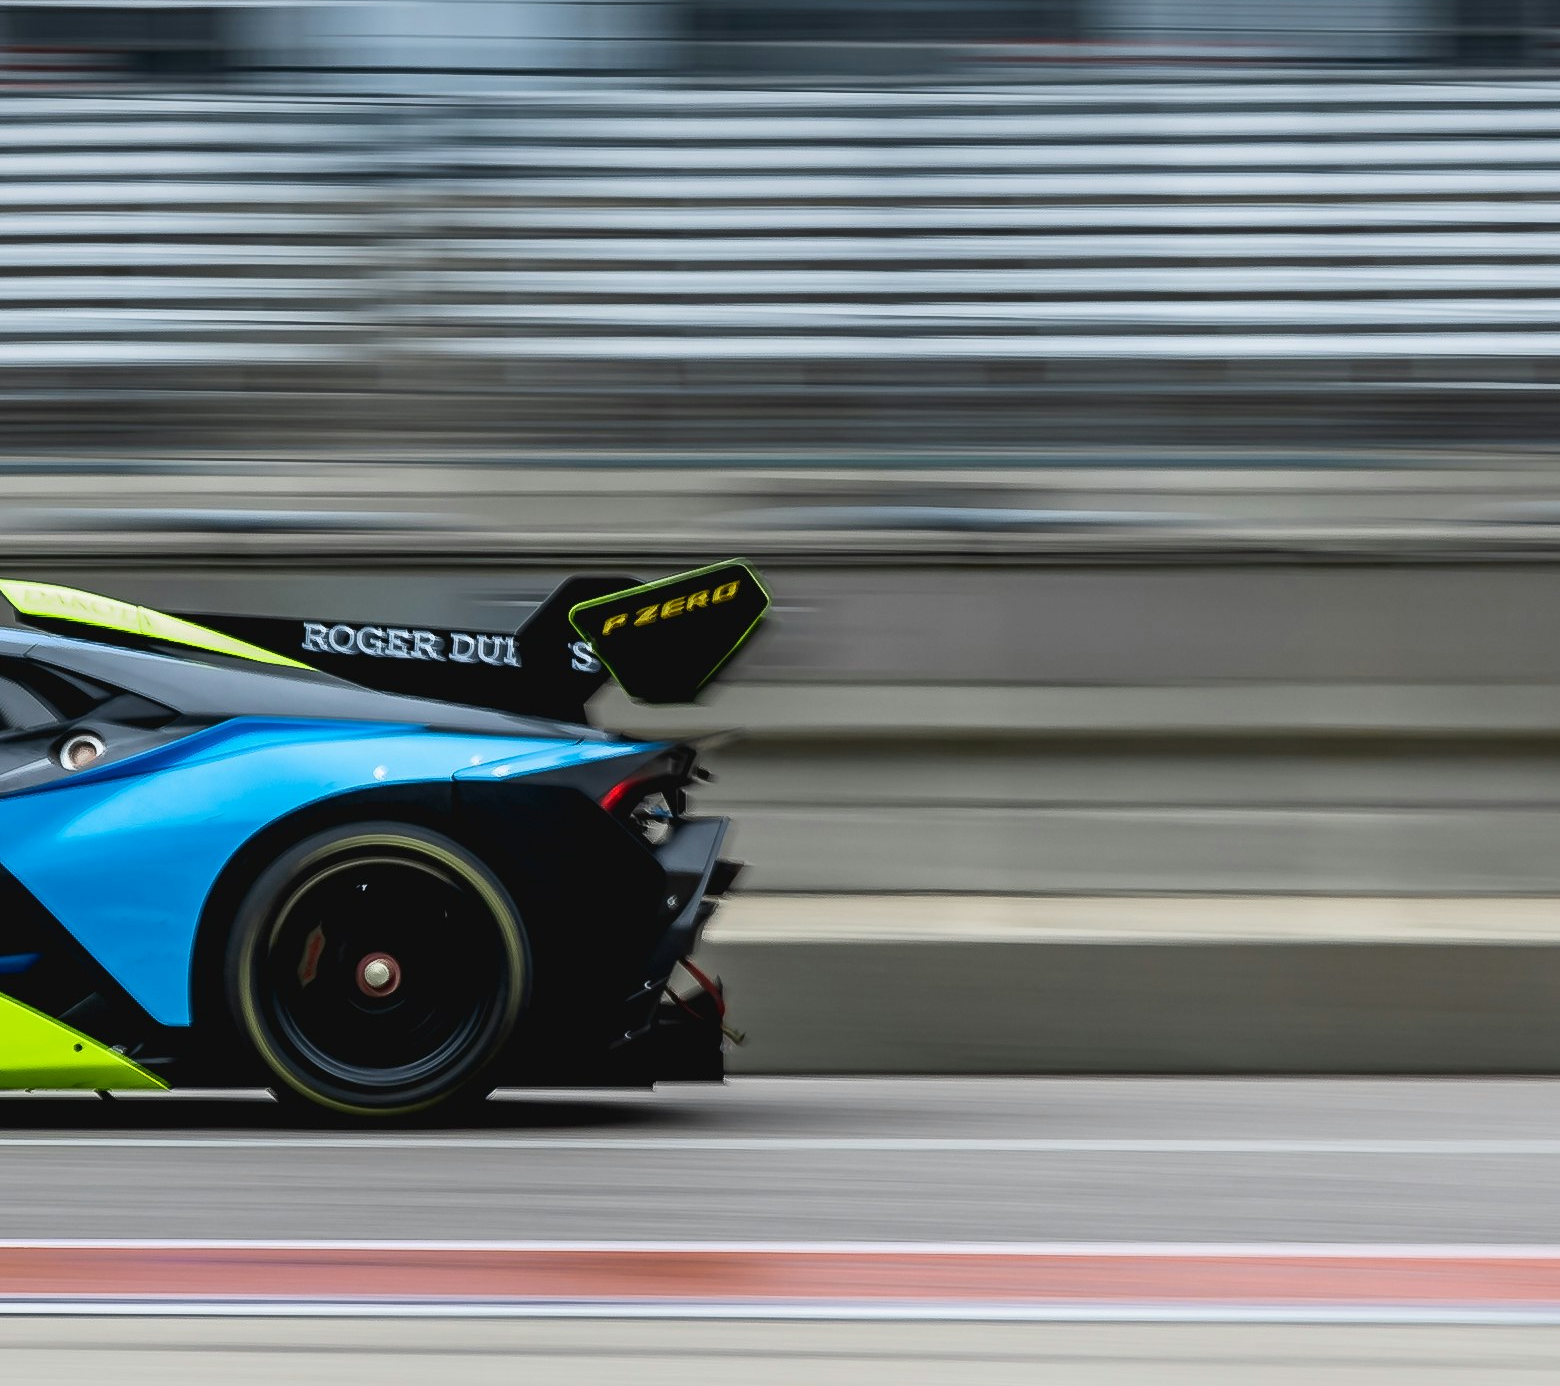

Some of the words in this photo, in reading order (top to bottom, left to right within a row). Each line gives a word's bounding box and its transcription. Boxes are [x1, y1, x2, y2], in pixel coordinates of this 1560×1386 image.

[602, 613, 629, 636] P
[634, 580, 741, 627] ZERO
[302, 621, 448, 662] ROGER
